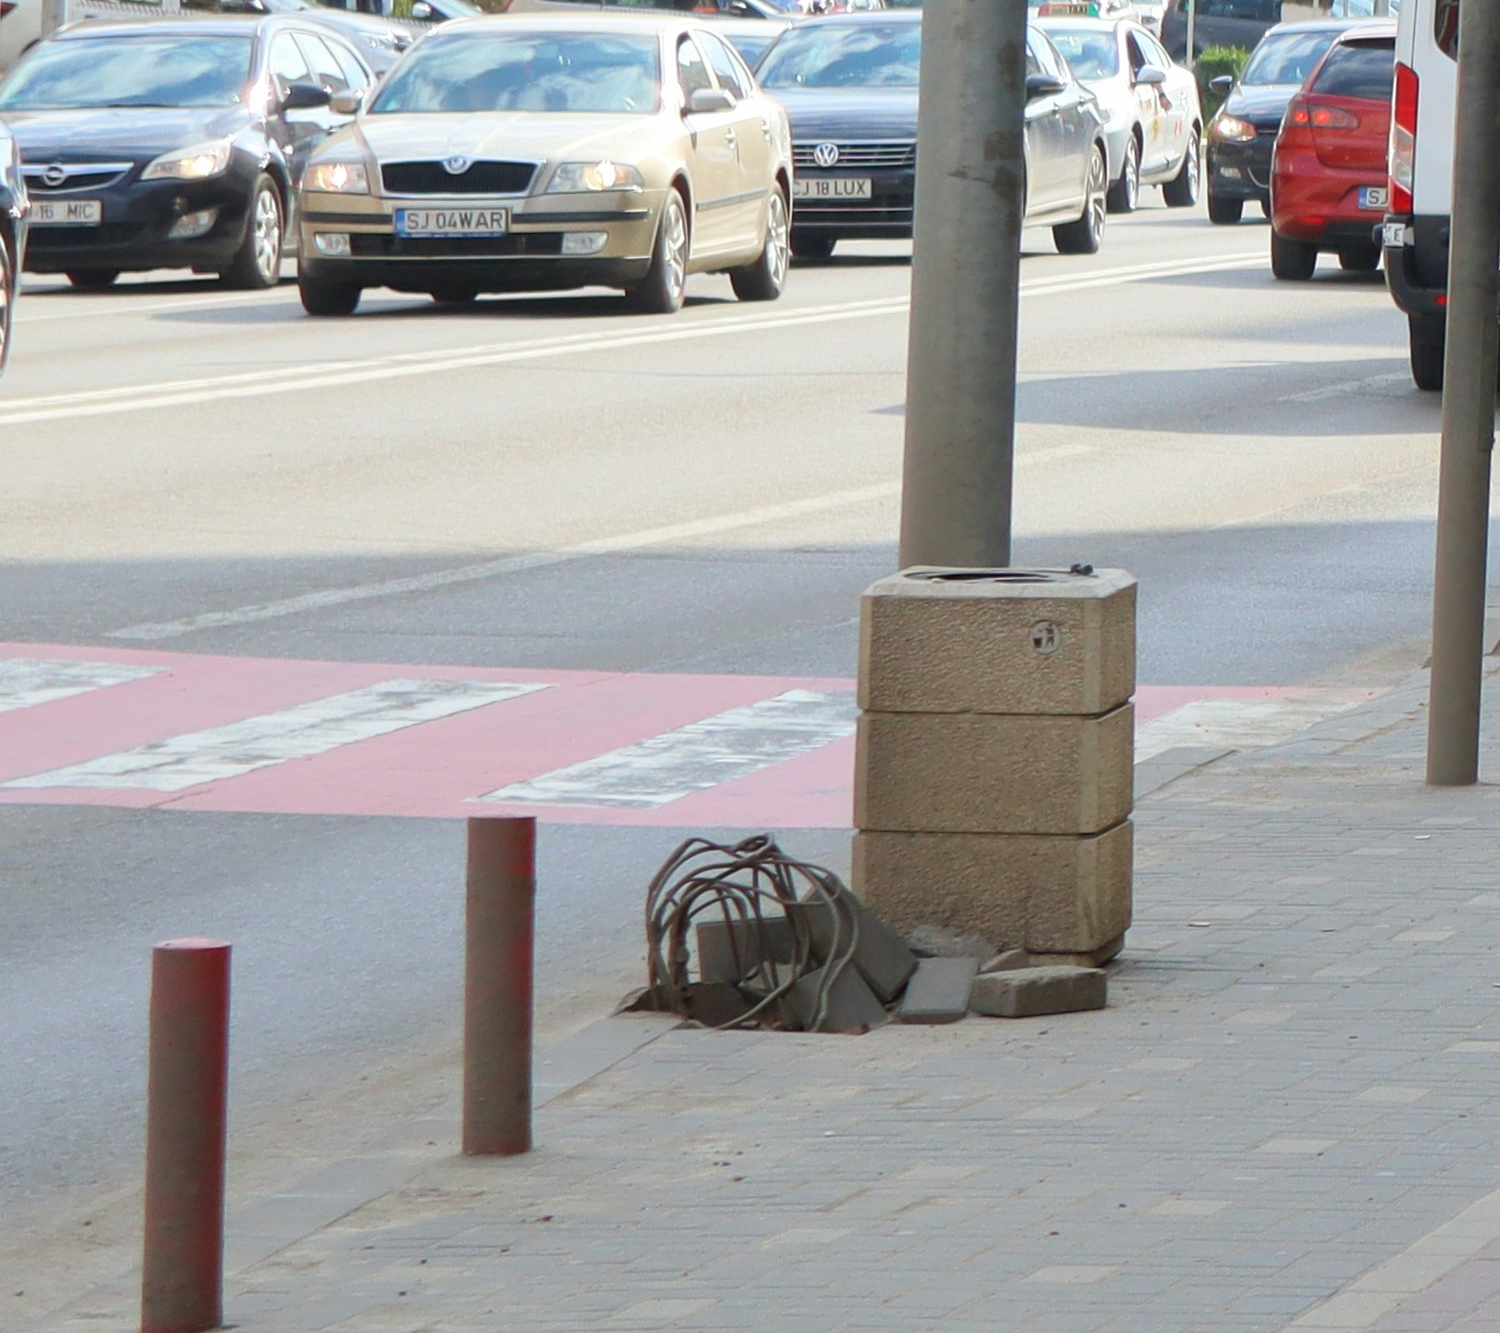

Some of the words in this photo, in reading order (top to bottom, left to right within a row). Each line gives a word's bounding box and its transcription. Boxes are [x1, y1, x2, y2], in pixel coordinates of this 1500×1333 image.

[815, 180, 829, 196] 18
[834, 180, 866, 196] LUX
[67, 203, 94, 219] MIC
[406, 212, 429, 230] SJ
